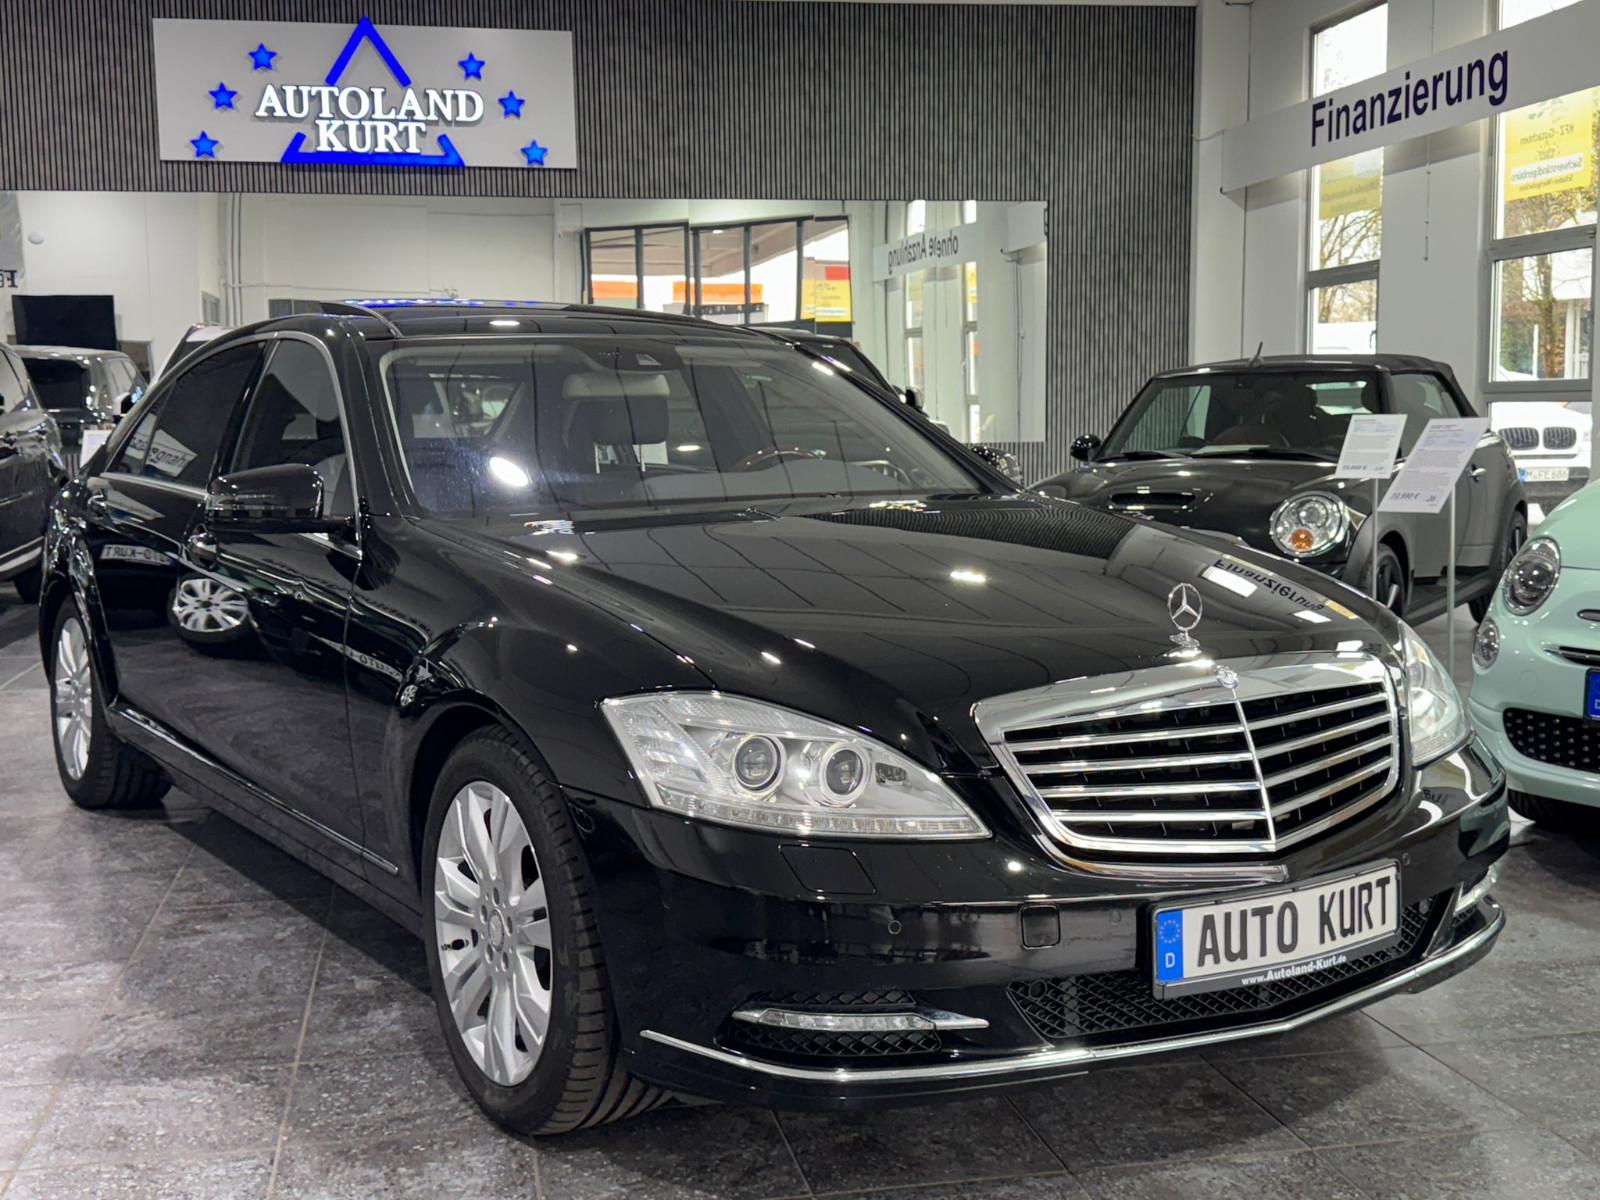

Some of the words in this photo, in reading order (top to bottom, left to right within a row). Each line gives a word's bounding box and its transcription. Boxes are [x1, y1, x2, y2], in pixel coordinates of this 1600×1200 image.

[255, 84, 485, 123] AUTOLAND
[1311, 50, 1509, 148] Finanzierung
[315, 119, 427, 154] KURT
[1197, 900, 1299, 967] AUTO
[1318, 876, 1391, 945] KURT
[1165, 952, 1175, 968] D
[1241, 954, 1347, 986] www.Autoland-Kurt.de
